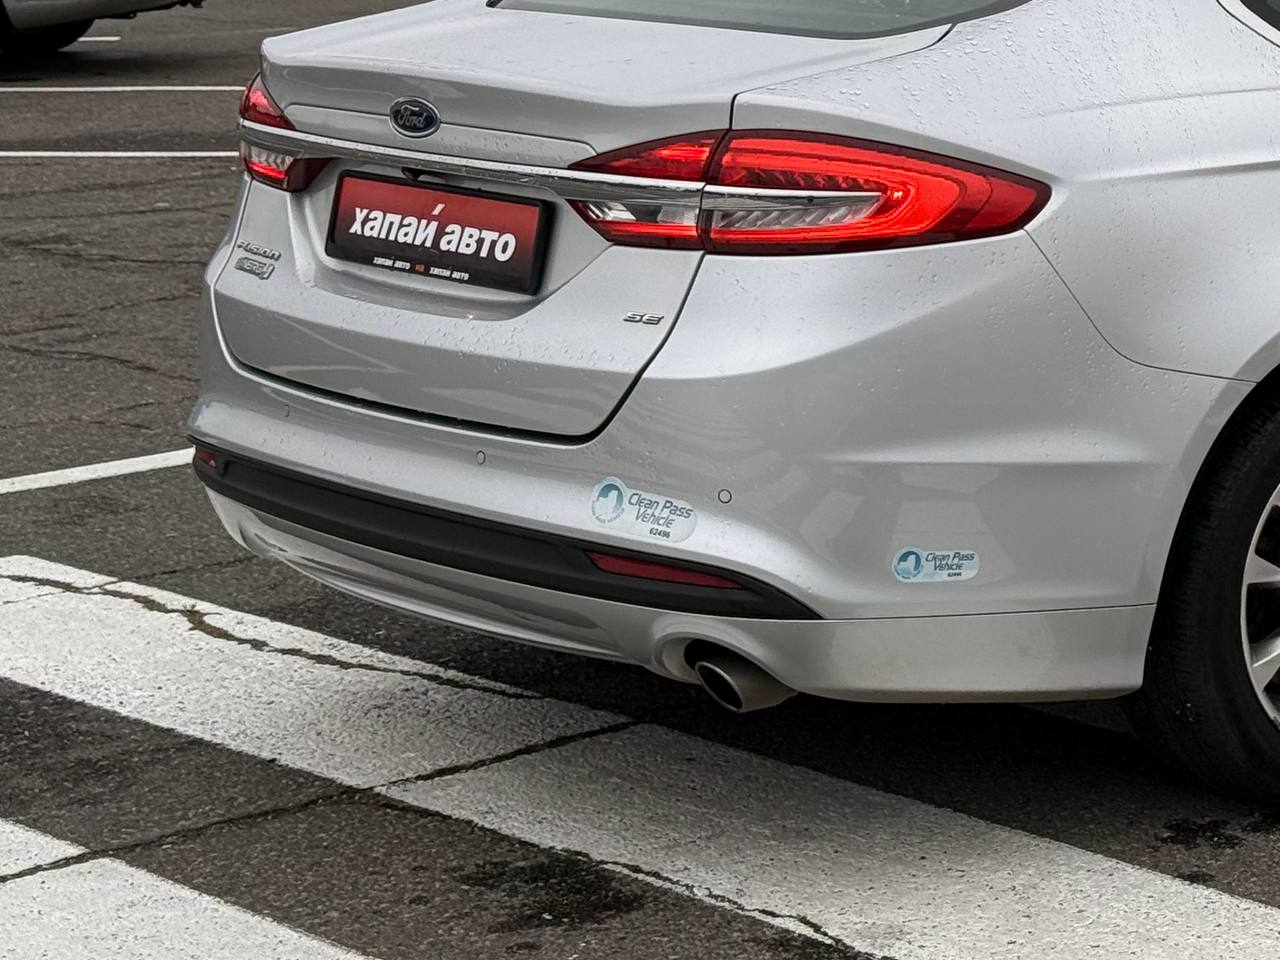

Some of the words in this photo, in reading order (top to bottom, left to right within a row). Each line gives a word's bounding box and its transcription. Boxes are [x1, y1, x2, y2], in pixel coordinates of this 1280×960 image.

[398, 104, 428, 128] Ford
[440, 223, 516, 262] авто
[623, 311, 664, 325] SE
[628, 492, 659, 511] Clean
[659, 500, 694, 519] Pass
[635, 509, 676, 528] Vehicle
[951, 552, 976, 563] Pass
